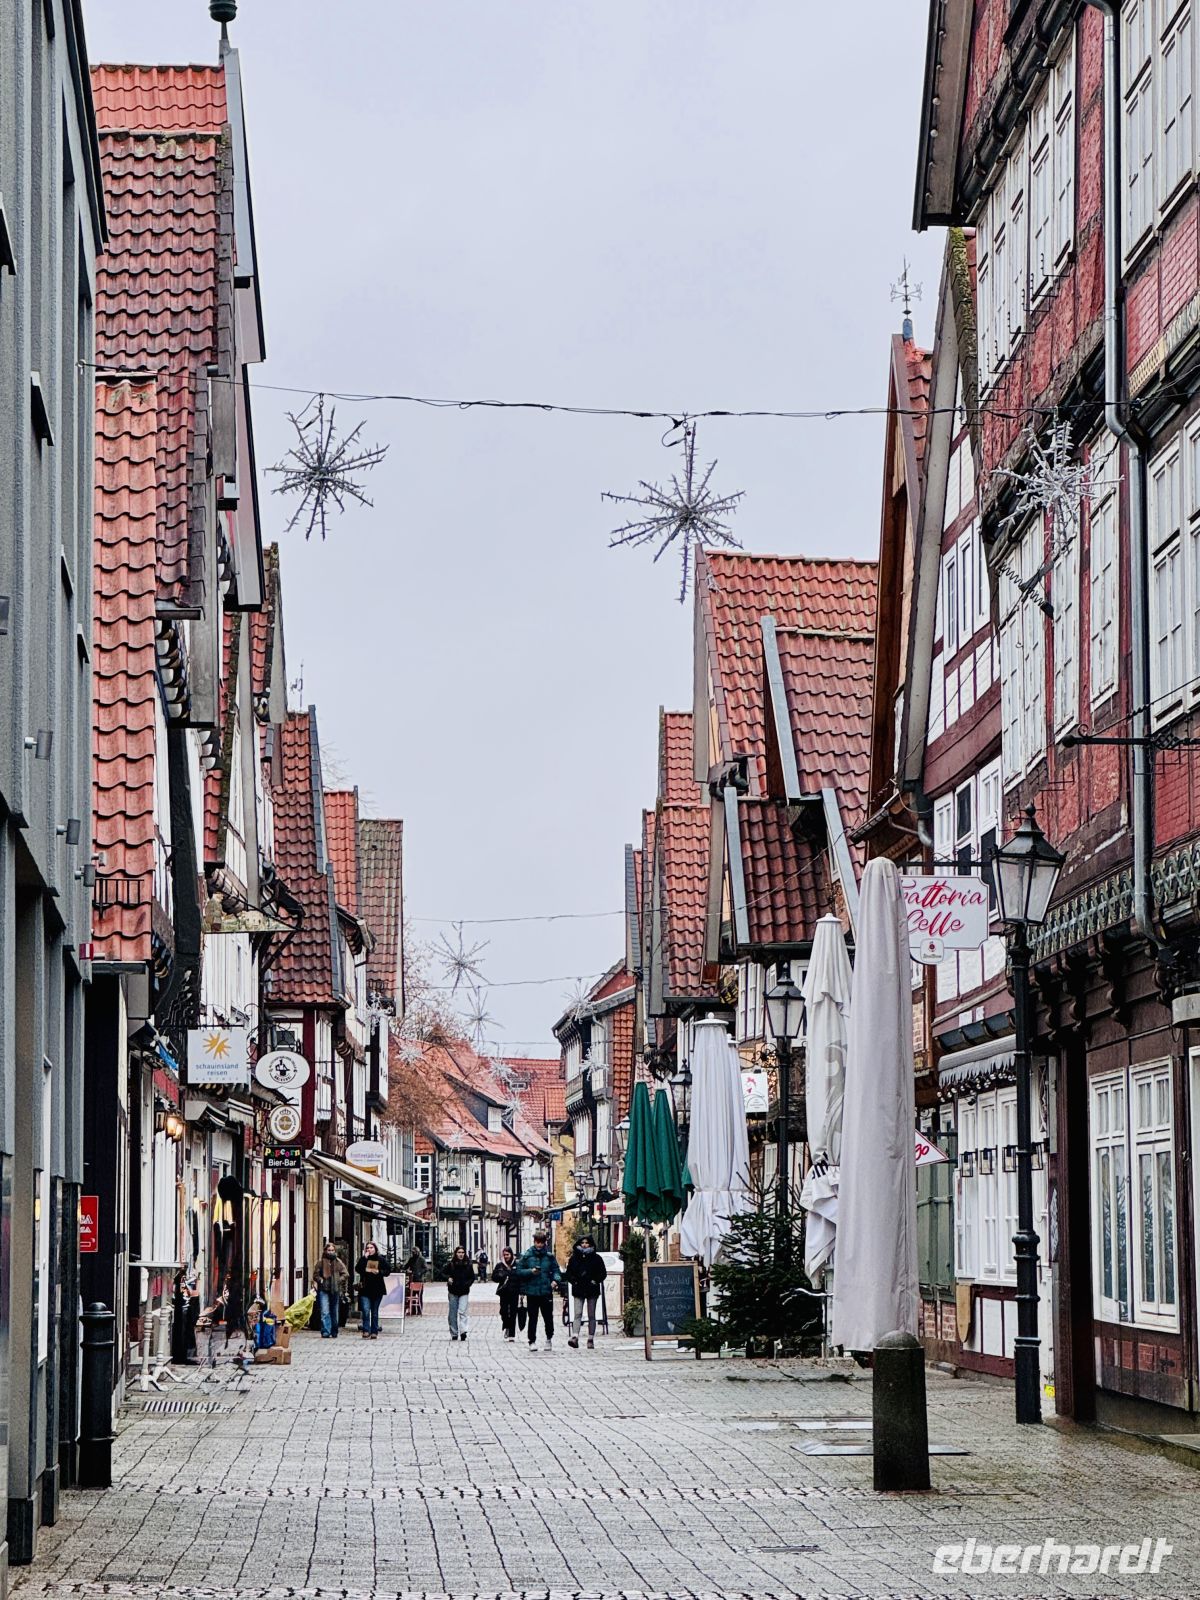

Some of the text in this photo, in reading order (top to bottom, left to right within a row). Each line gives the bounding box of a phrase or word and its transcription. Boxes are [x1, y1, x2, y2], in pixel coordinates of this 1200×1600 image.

[907, 909, 965, 937] Celle
[264, 1147, 300, 1158] Popcorn
[268, 1158, 297, 1167] Bier-Bar
